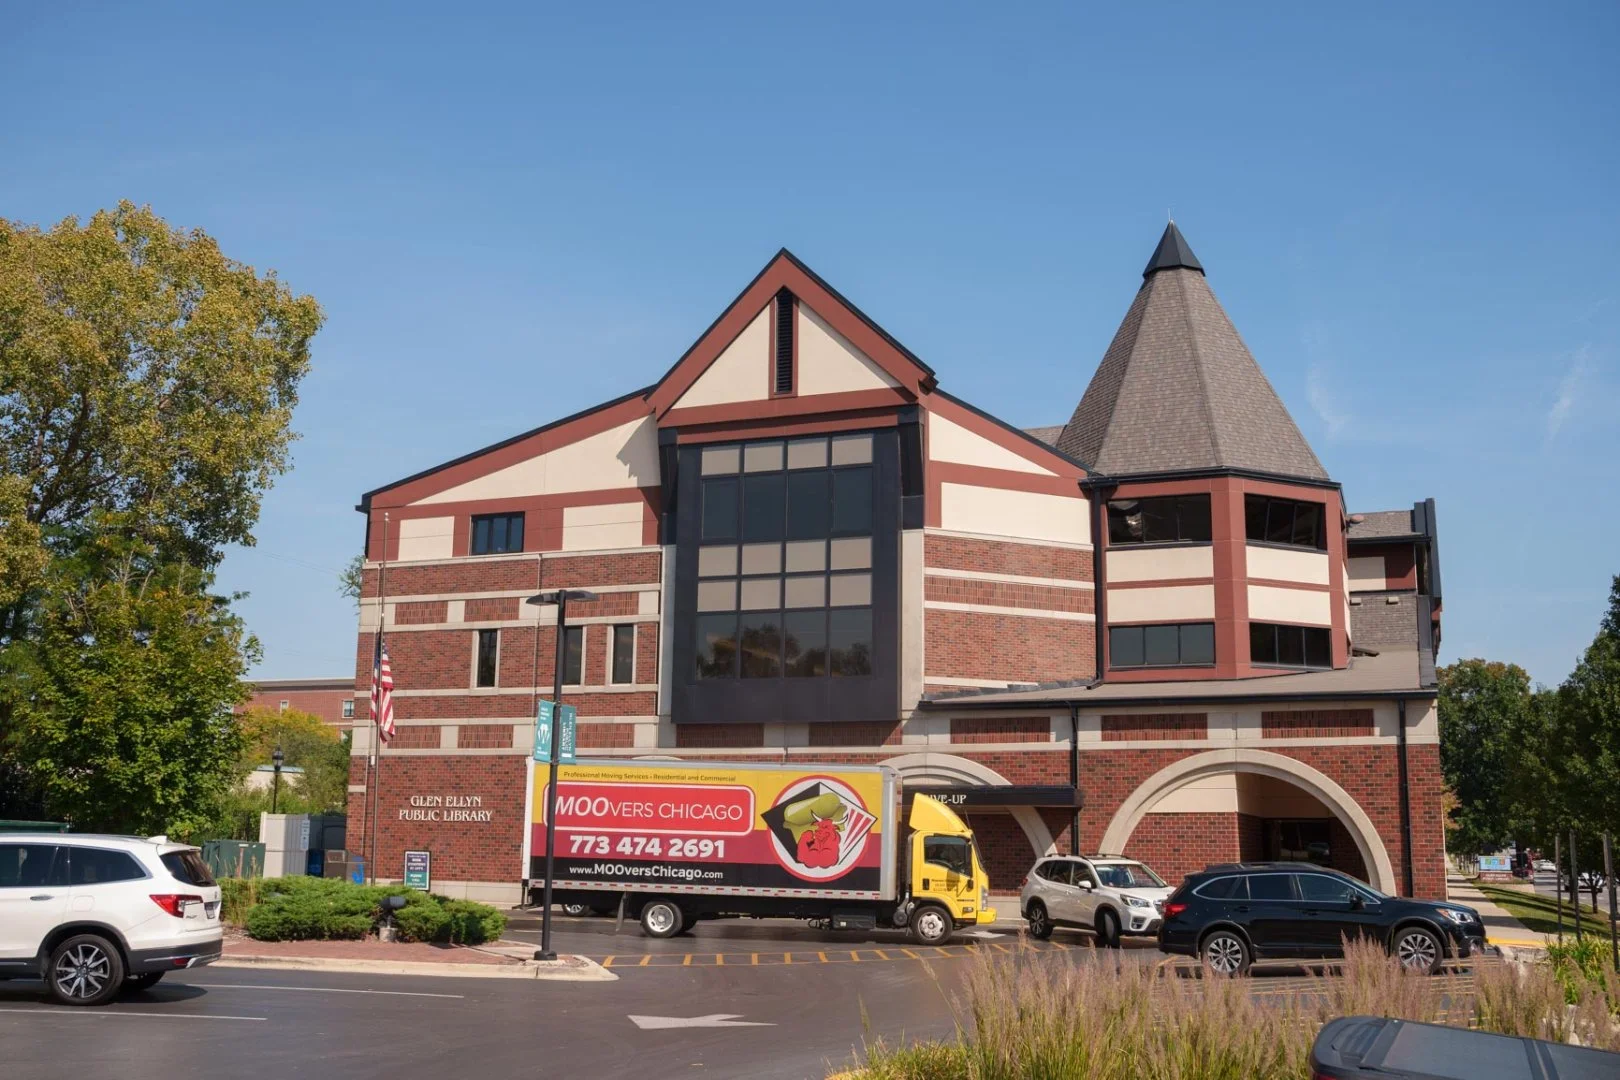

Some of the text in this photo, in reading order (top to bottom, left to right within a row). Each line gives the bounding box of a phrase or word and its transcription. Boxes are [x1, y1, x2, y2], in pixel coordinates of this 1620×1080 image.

[410, 795, 482, 808] GLEN ELLYN
[929, 794, 967, 804] IVE-UP
[399, 809, 493, 822] PUBLIC LIBRARY
[555, 796, 743, 821] MOOVERS CHICAGO
[569, 835, 725, 858] 773 474 2691
[569, 863, 724, 880] www.MOOversChicago.com
